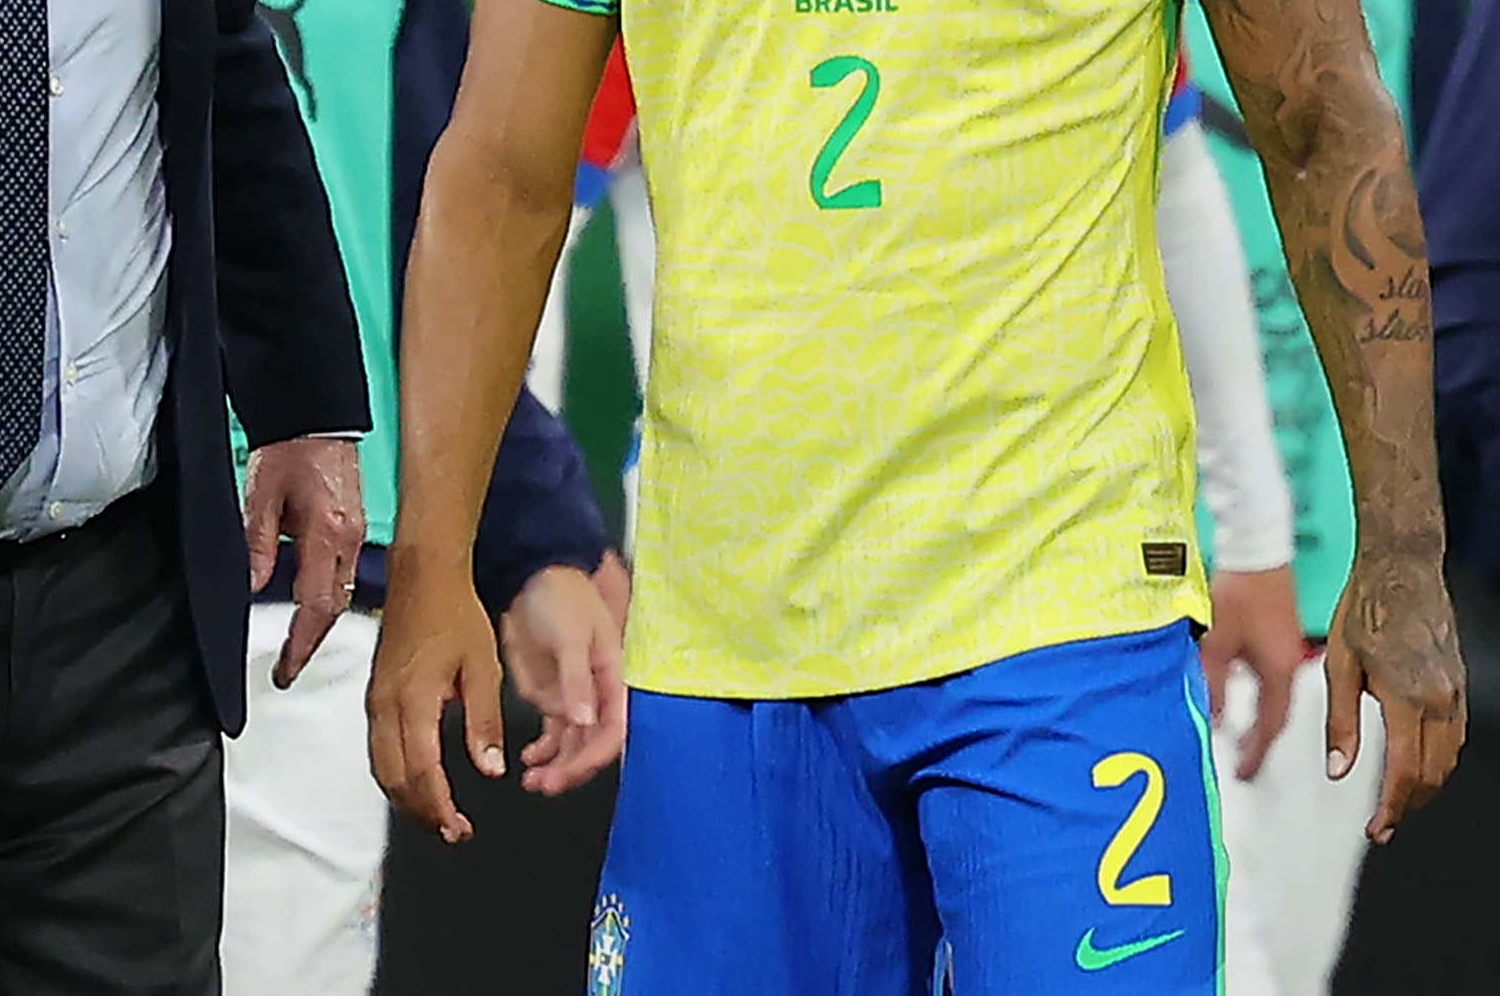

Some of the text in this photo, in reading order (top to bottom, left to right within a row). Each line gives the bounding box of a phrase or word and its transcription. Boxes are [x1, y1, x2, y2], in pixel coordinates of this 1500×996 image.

[809, 54, 883, 210] 2
[1379, 264, 1430, 300] sta
[1091, 750, 1174, 907] 2
